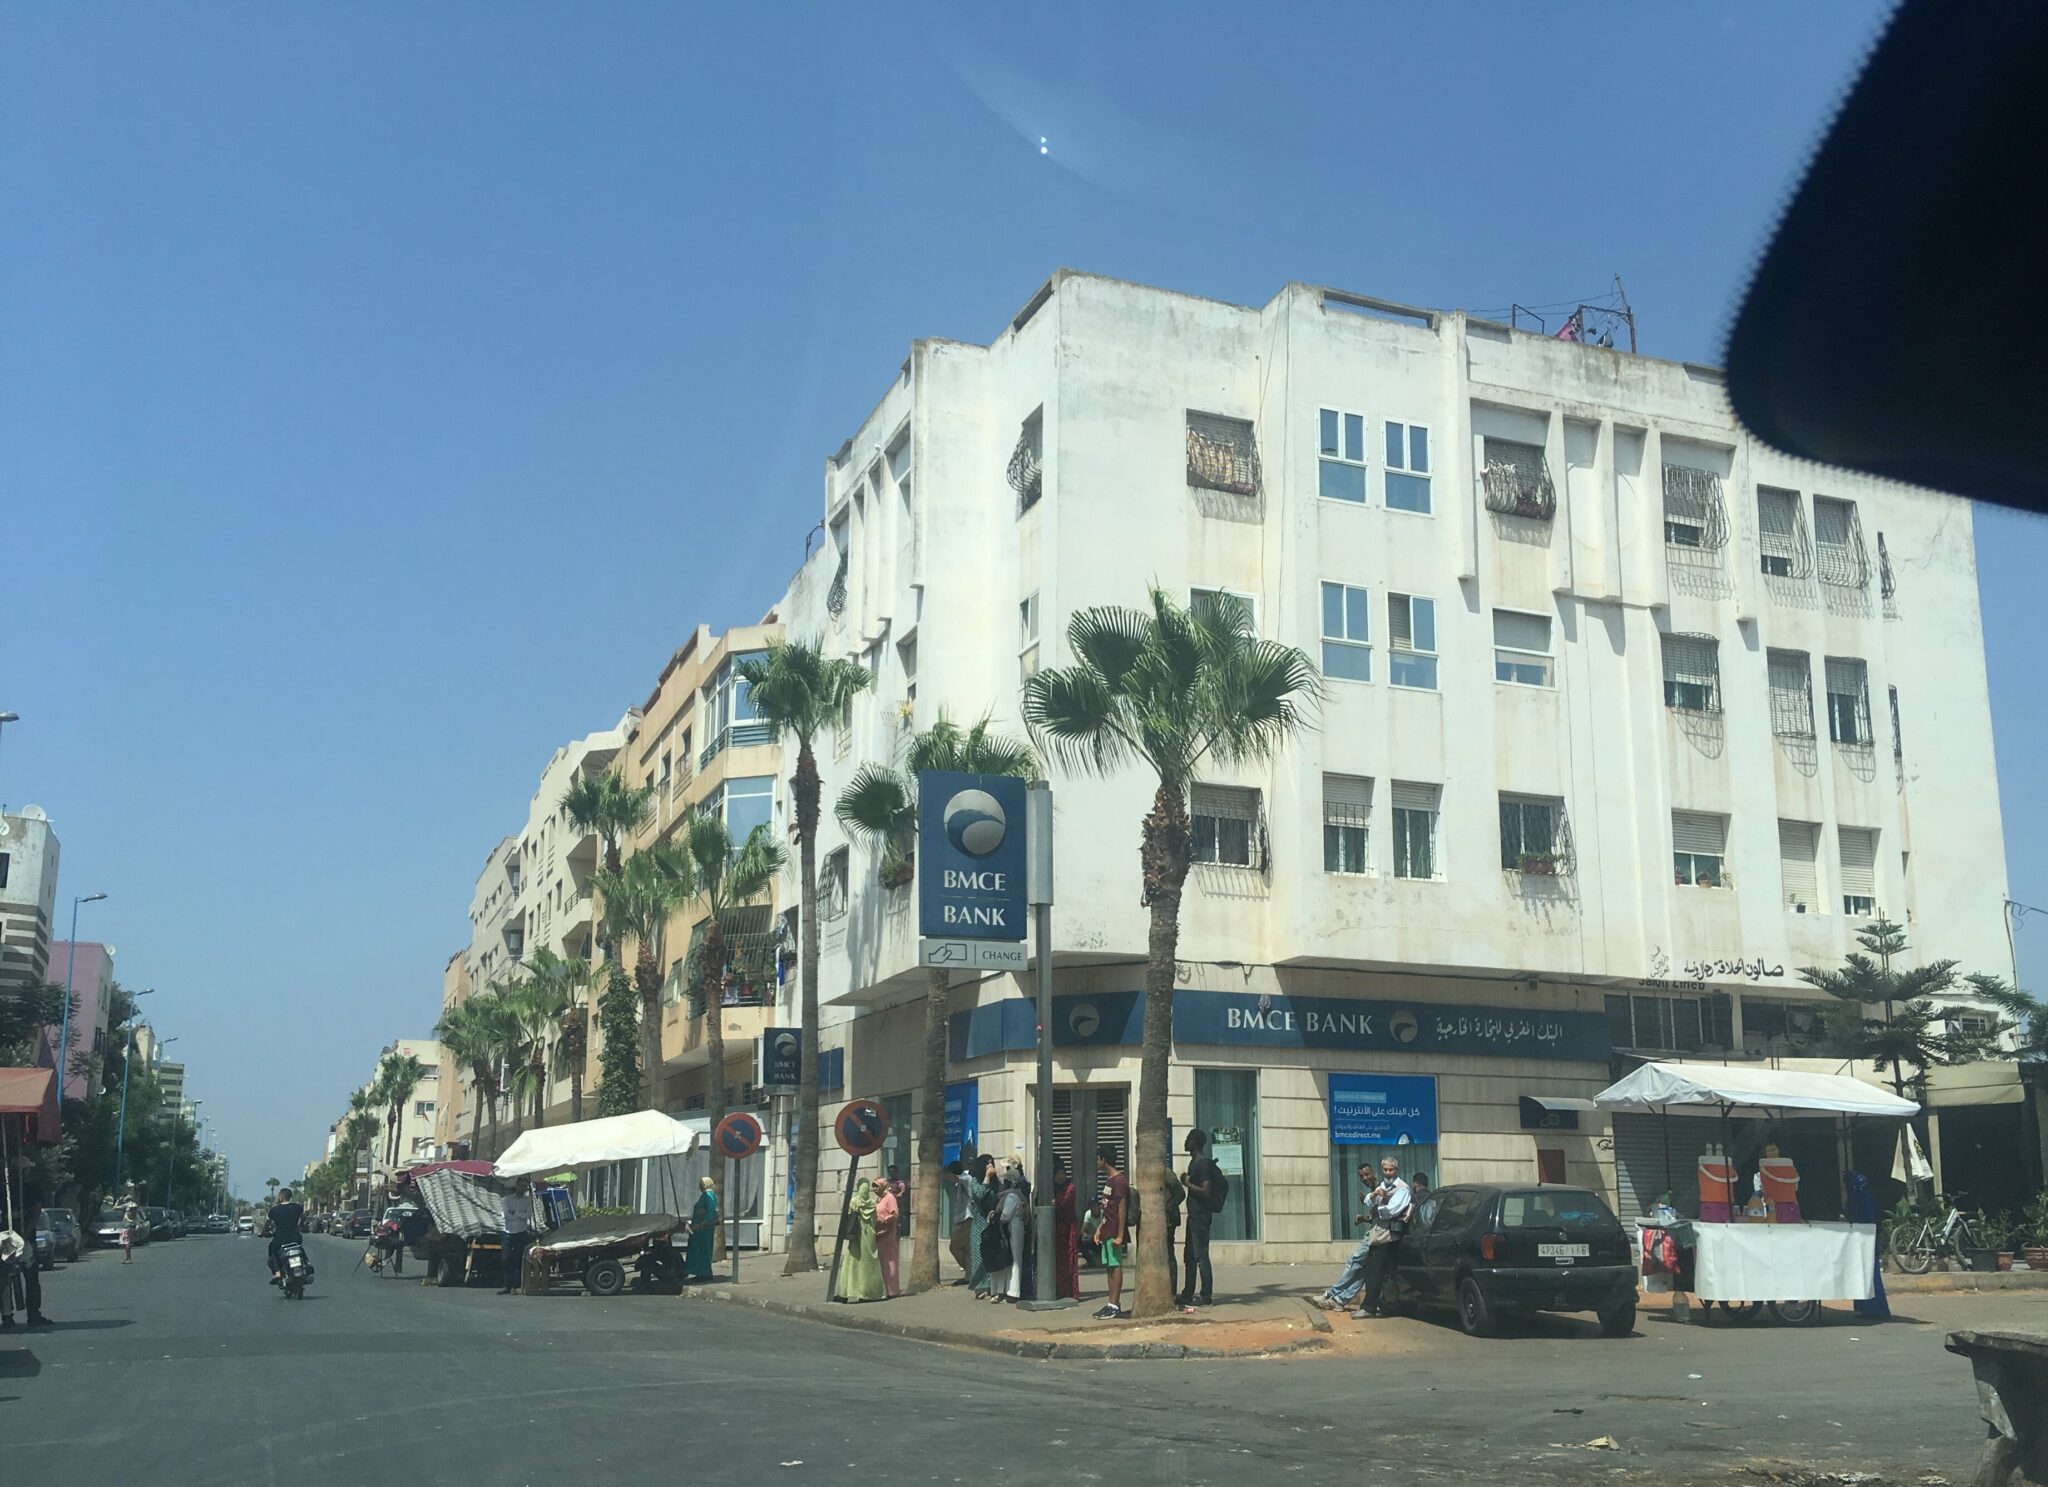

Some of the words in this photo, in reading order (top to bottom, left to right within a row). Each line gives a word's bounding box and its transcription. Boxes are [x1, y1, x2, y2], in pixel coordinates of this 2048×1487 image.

[944, 869, 1007, 891] BMCE
[944, 905, 1006, 927] BANK
[982, 950, 1023, 961] CHANGE
[1714, 957, 1745, 975] الحلاقة
[1745, 956, 1784, 982] صالون
[1227, 1007, 1296, 1031] BMCE
[1306, 1011, 1373, 1035] BANK
[1436, 1016, 1472, 1041] الخارجية
[1475, 1017, 1502, 1042] للتجارة
[1504, 1019, 1535, 1044] المغربي
[1537, 1023, 1563, 1047] البنك
[1371, 1106, 1385, 1117] على
[1386, 1106, 1408, 1117] البنك
[1408, 1106, 1421, 1118] كل
